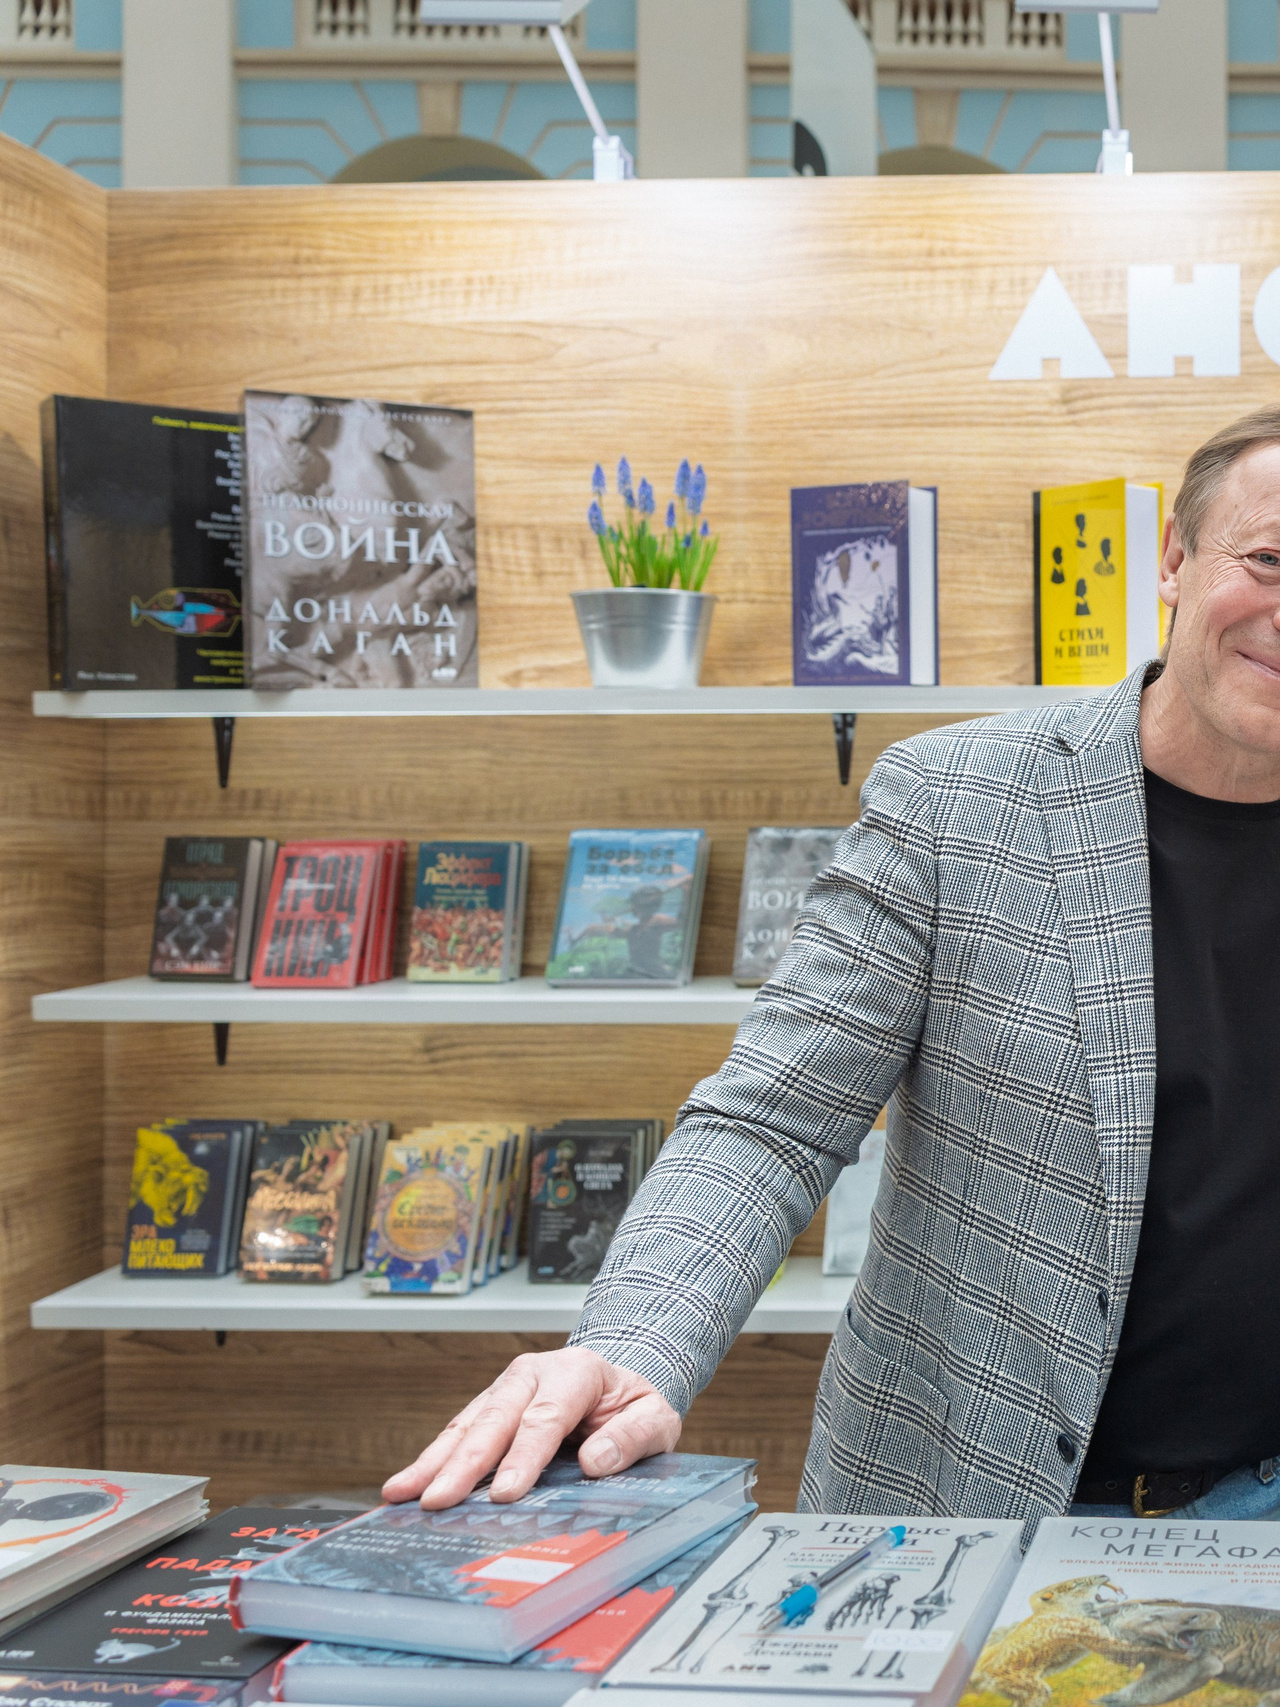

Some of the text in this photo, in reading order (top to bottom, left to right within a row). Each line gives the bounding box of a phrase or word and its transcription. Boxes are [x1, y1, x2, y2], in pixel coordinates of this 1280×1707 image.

[264, 516, 459, 567] ВОЙНА
[264, 597, 459, 627] ДОНАЛЬД
[266, 628, 459, 657] КАГАН
[747, 886, 805, 911] ВОЙ
[230, 1526, 322, 1540] ЗАГА
[815, 1521, 951, 1537] Перые
[1070, 1525, 1220, 1544] КОНЕЦ
[829, 1536, 920, 1547] шаи
[145, 1557, 256, 1572] ПАДА
[1059, 1558, 1158, 1566] УВЛЕКАТЕЛЬНАЯ
[1168, 1569, 1238, 1577] МАМОНТОВ,
[131, 1593, 232, 1609] КОШ
[145, 1617, 207, 1627] ФИЗИКА
